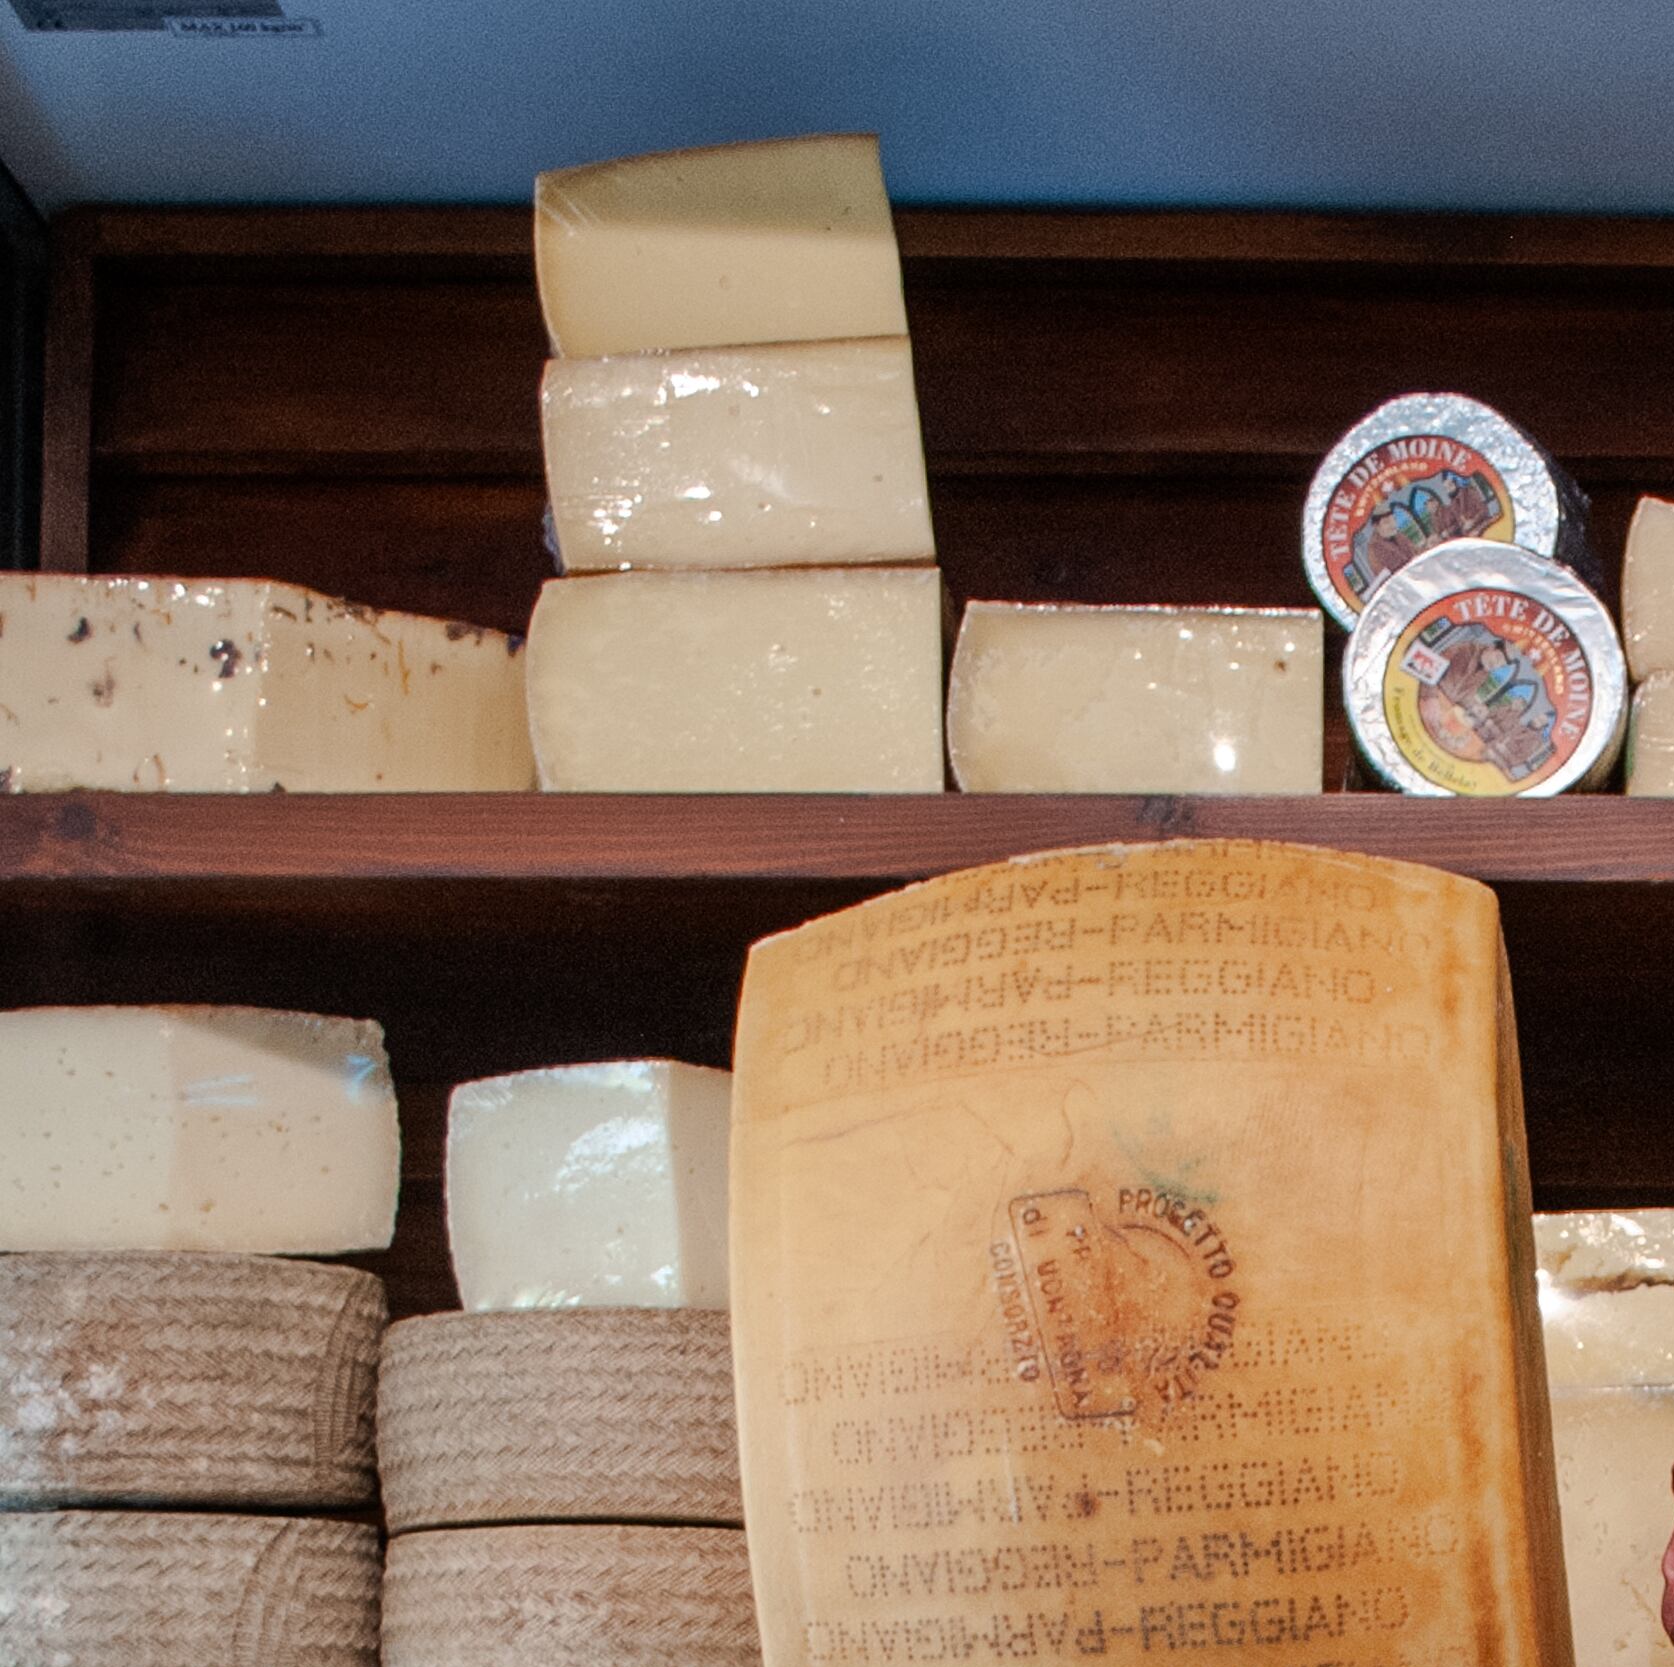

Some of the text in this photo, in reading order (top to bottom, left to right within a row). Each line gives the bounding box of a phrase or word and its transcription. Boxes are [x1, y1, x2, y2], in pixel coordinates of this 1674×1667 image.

[1349, 453, 1384, 488] DE
[1387, 438, 1472, 471] MOINE
[1532, 608, 1570, 647] DE
[1559, 648, 1589, 741] MOINE
